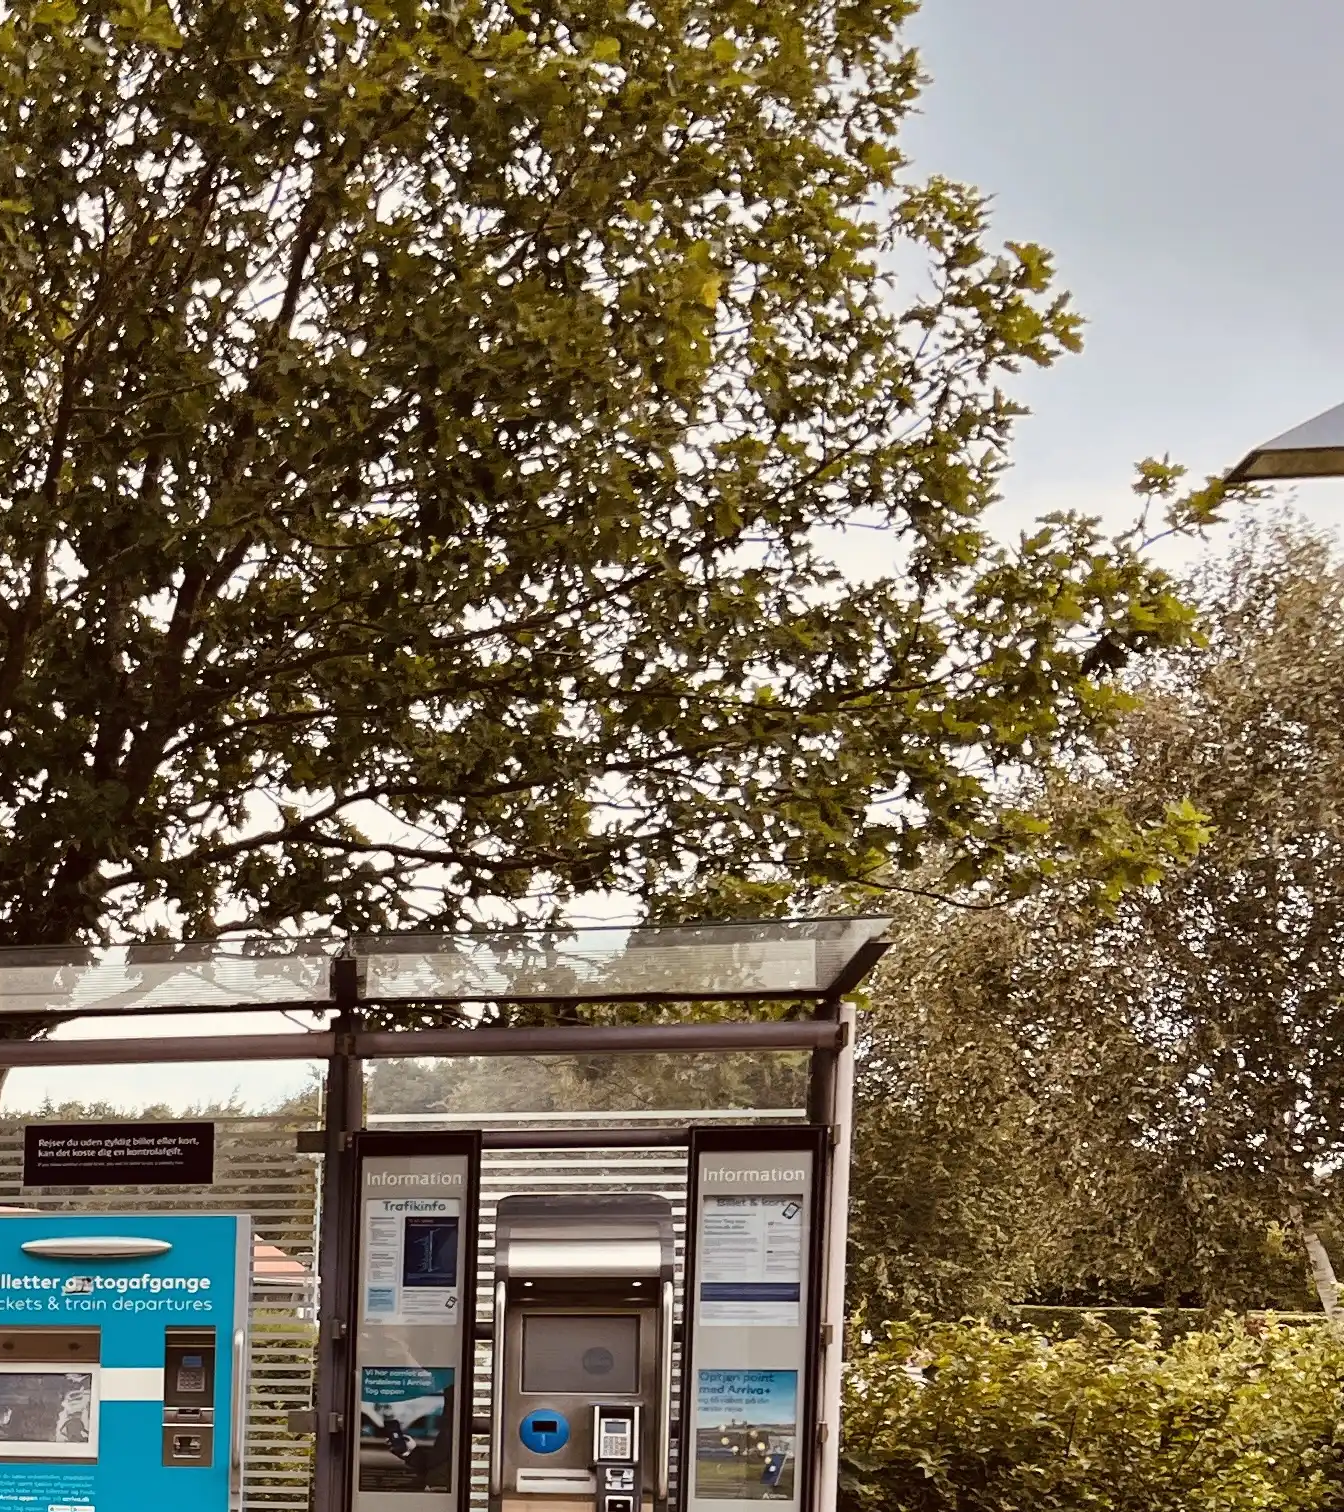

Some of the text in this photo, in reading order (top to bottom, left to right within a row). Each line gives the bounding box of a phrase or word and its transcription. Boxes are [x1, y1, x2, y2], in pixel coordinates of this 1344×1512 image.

[38, 1136, 200, 1149] Rejser du uden gyldig billet eller kort,
[38, 1149, 54, 1158] kan
[55, 1148, 71, 1157] det
[72, 1148, 96, 1157] koste
[97, 1147, 112, 1158] dig
[113, 1149, 125, 1157] en
[366, 1171, 462, 1187] Information
[703, 1167, 805, 1183] Information
[382, 1200, 447, 1212] Trafikinfo
[95, 1273, 212, 1294] togafgange
[47, 1295, 60, 1311] &
[64, 1297, 107, 1311] train
[112, 1296, 213, 1315] departures
[699, 1372, 775, 1384] Optjen point
[699, 1384, 725, 1394] med
